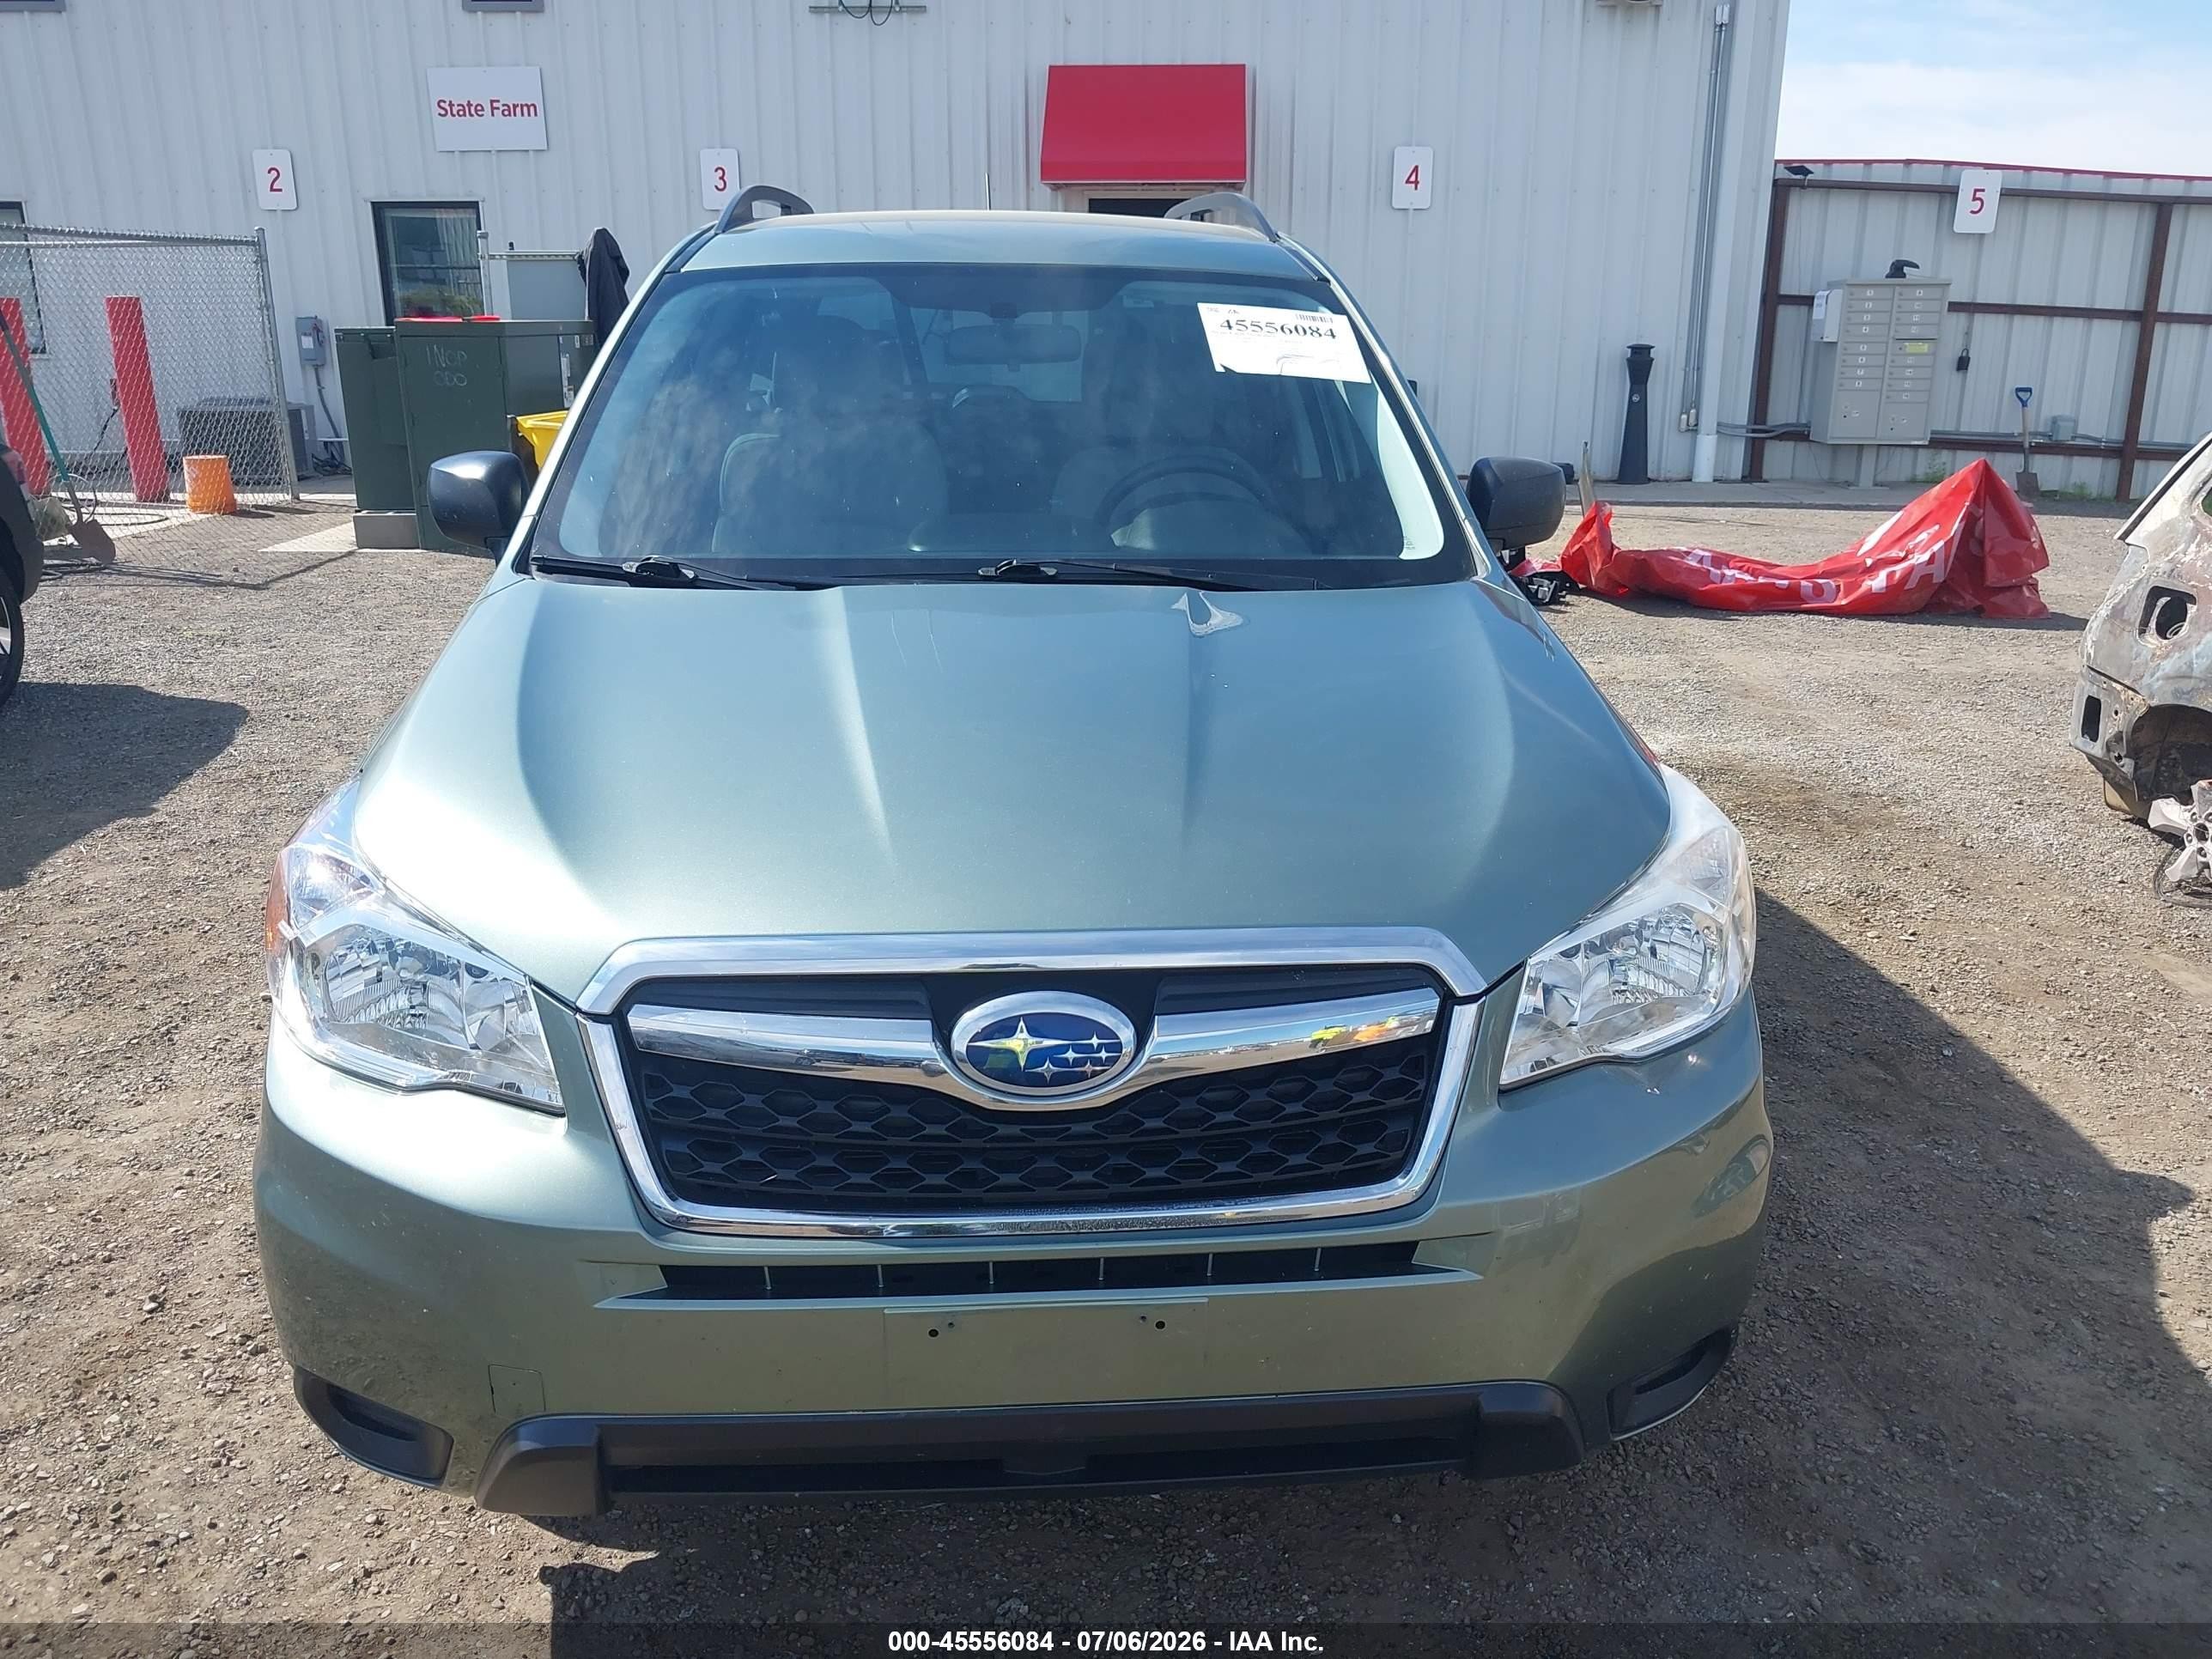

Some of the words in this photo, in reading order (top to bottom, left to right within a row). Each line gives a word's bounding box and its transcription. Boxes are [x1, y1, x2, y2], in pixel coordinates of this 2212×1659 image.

[436, 99, 485, 118] State
[489, 99, 538, 118] Farm
[267, 167, 283, 193] 2
[714, 167, 727, 192] 3
[1404, 165, 1420, 191] 4
[1969, 188, 1985, 216] 5
[1219, 319, 1337, 339] 45556084
